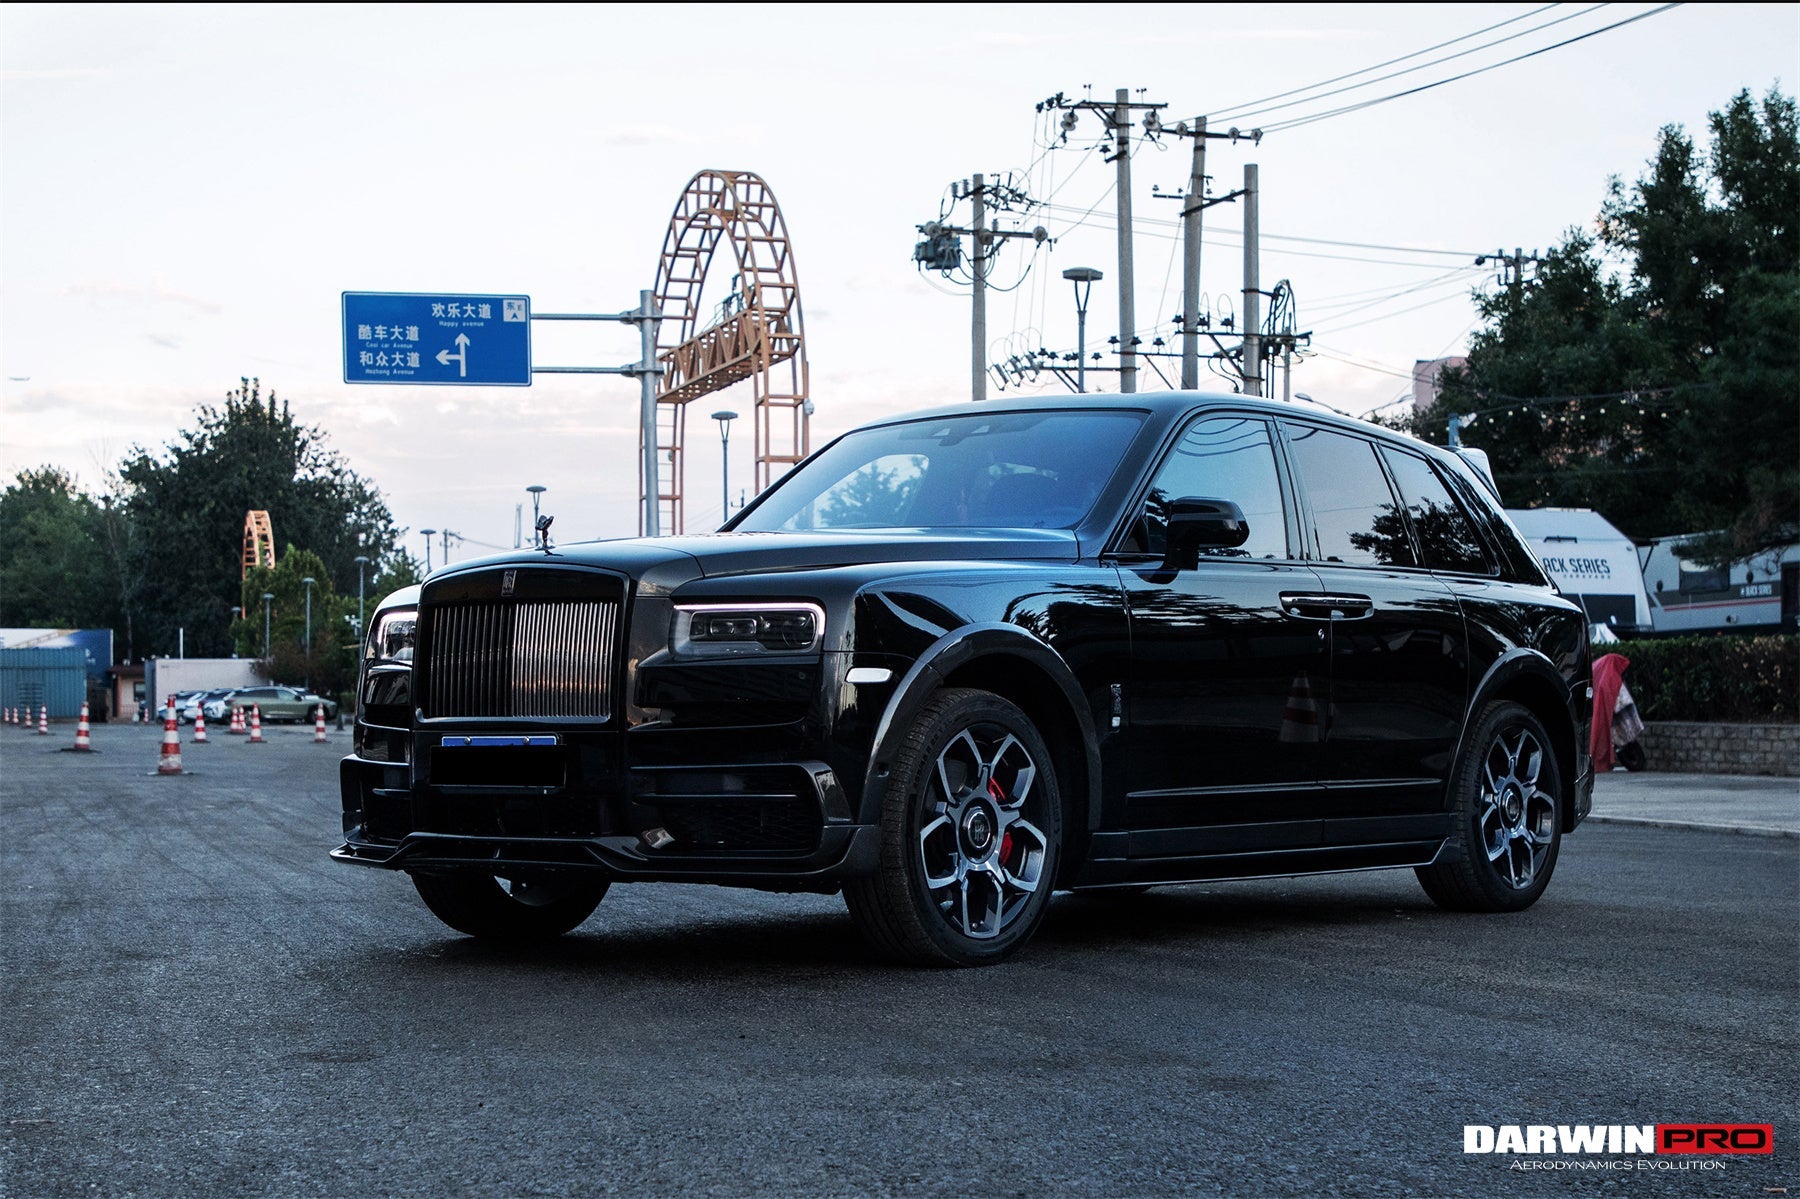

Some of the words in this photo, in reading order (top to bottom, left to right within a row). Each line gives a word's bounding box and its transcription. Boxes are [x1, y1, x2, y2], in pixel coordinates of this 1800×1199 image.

[431, 302, 492, 319] 欢乐大道
[358, 324, 419, 341] 酷车大道
[359, 350, 420, 368] 和众大道
[1542, 557, 1568, 573] ACK
[1568, 557, 1611, 574] SERIES
